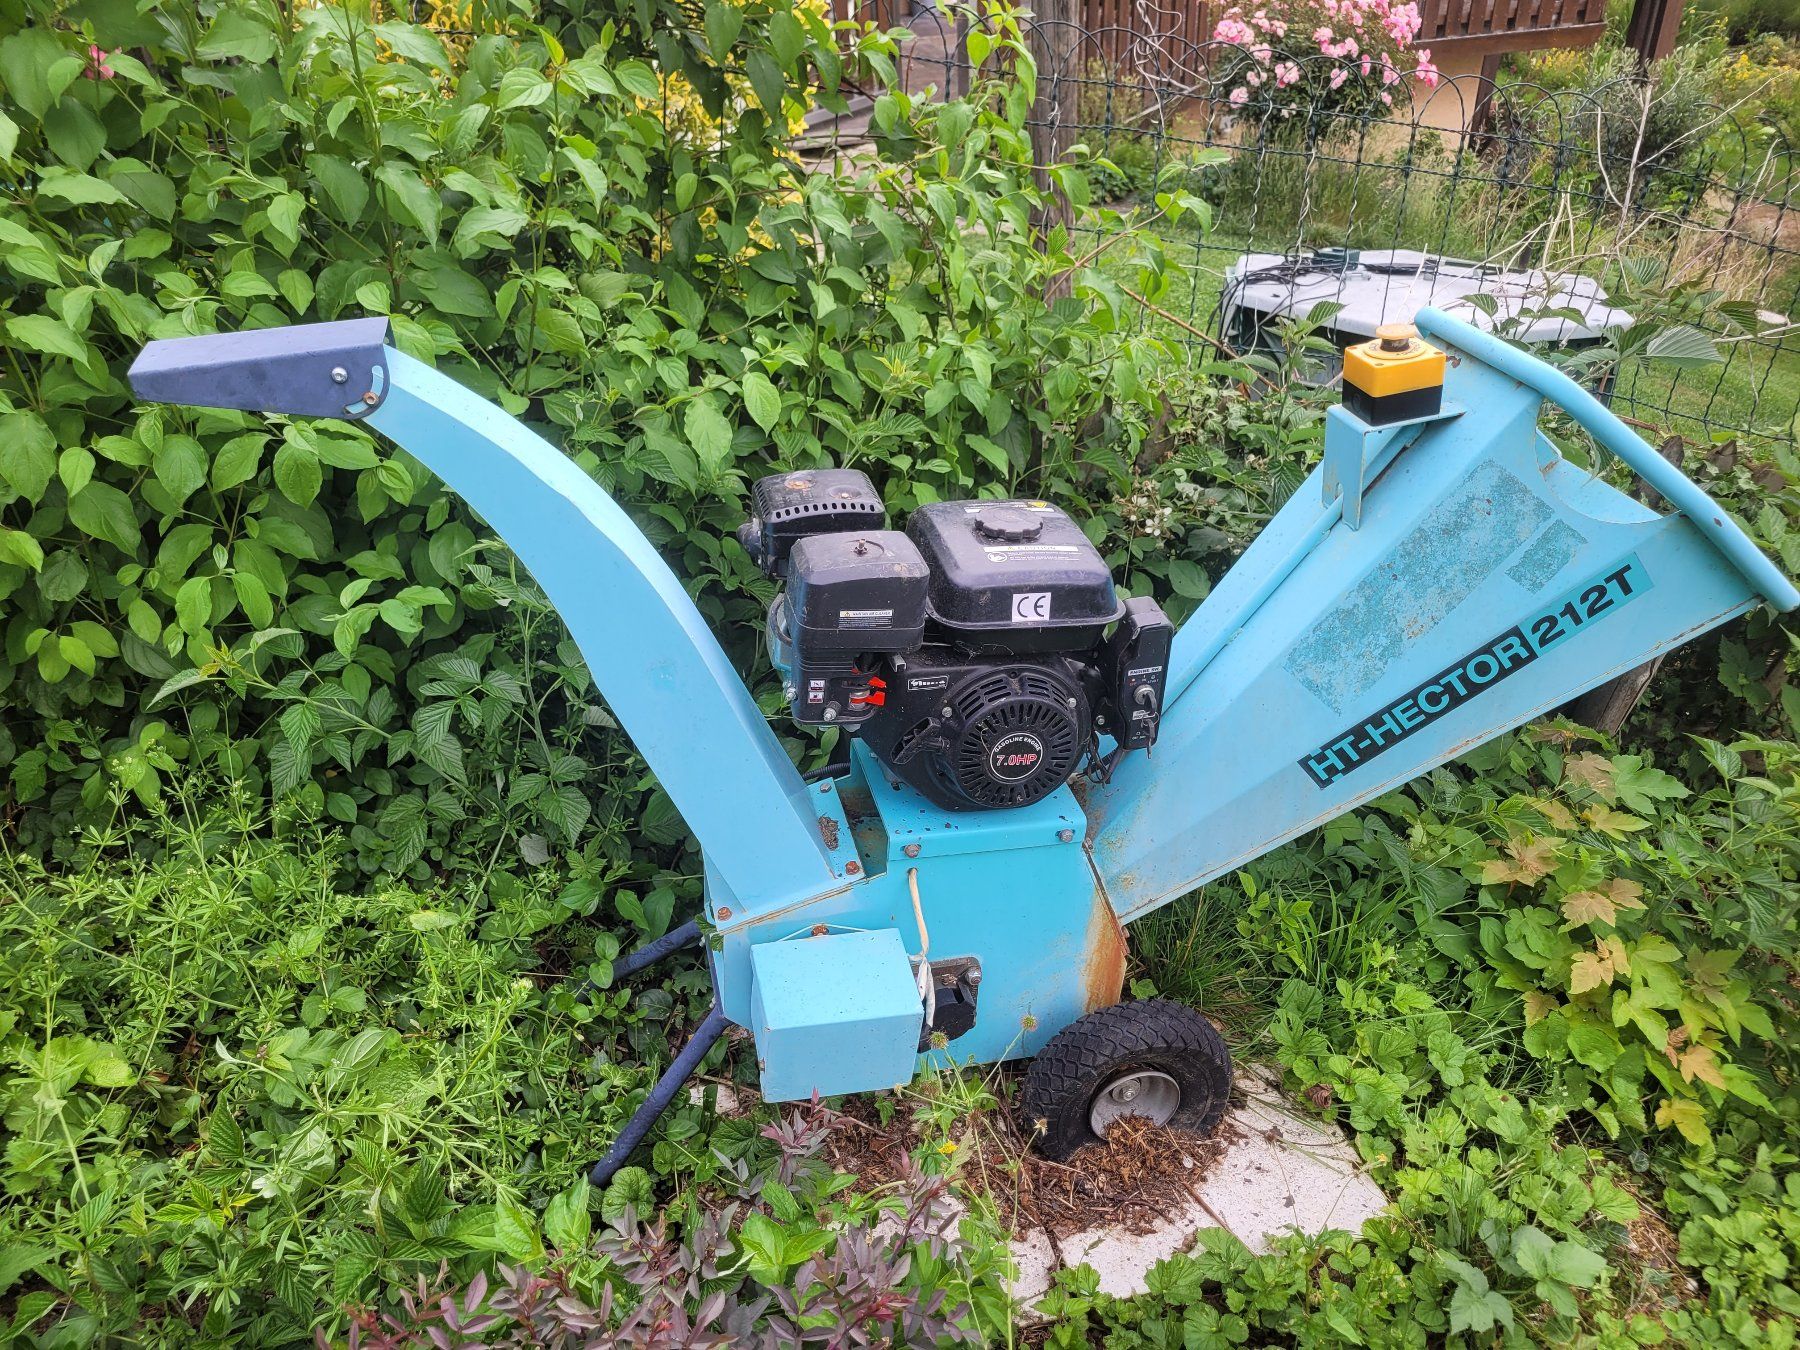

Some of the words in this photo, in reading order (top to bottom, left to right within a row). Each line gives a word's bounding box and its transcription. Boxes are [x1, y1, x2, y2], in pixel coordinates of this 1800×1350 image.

[1017, 595, 1047, 619] CE
[1307, 635, 1530, 784] HT-HECTOR
[1531, 564, 1634, 649] 212T
[994, 736, 1024, 753] GASOLINE
[1023, 736, 1041, 752] ENGINE
[996, 753, 1038, 767] 7.0HP
